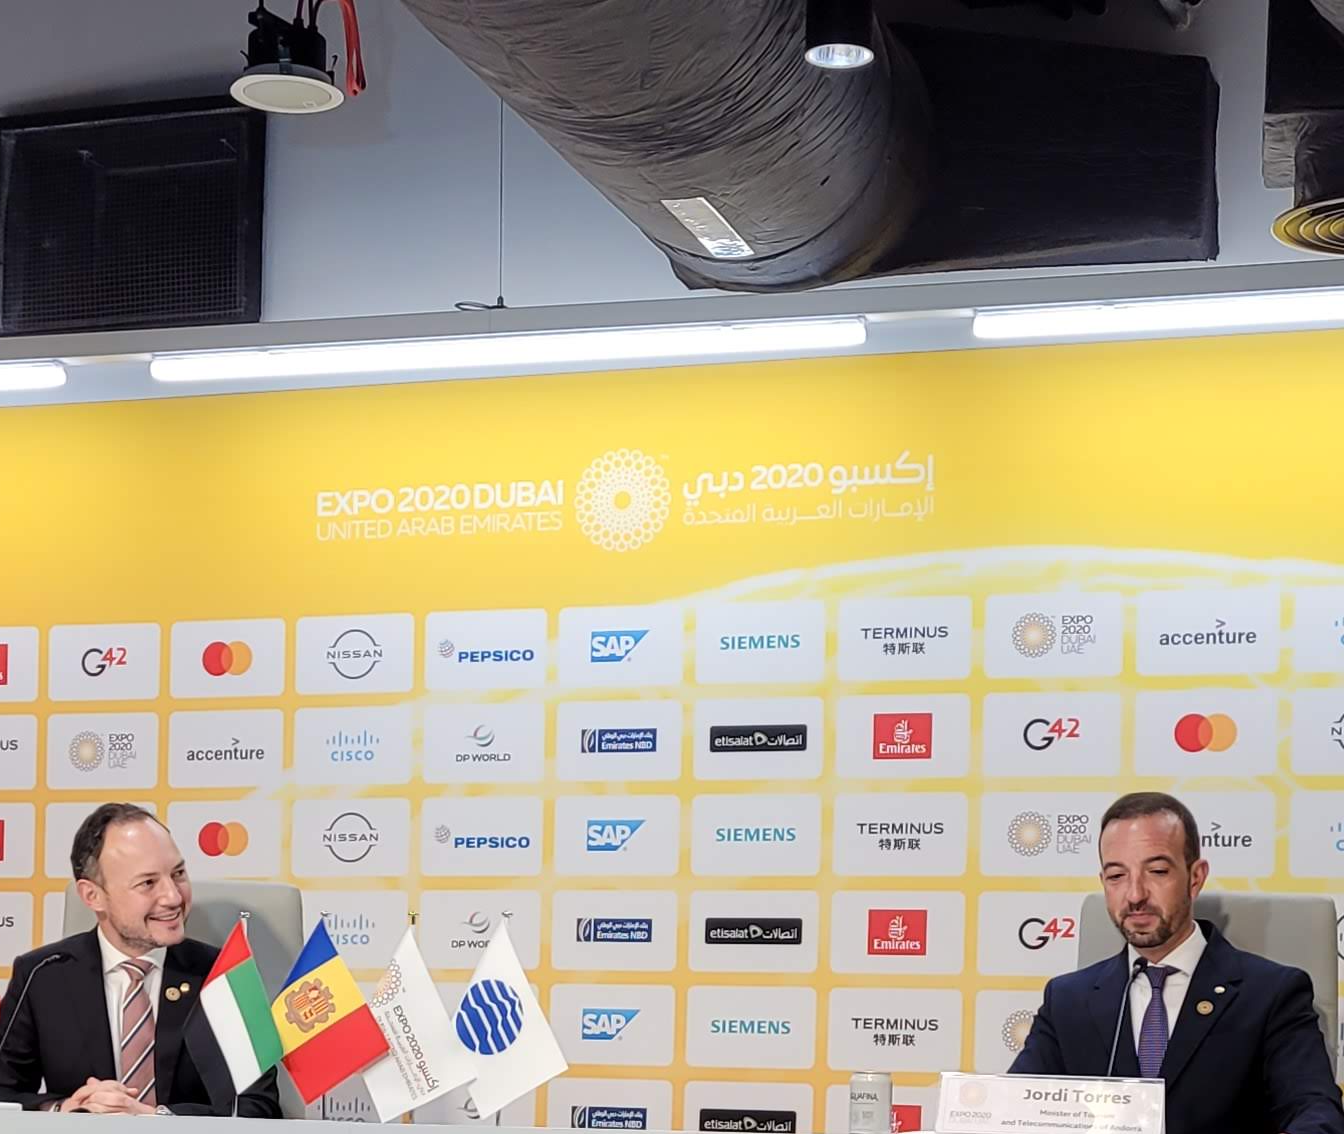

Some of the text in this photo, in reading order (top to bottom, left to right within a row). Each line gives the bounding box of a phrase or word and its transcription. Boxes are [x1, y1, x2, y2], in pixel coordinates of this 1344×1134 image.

[683, 451, 933, 505] إكسبو 2020 دبي
[317, 480, 564, 516] EXPO 2020 DUBAI
[683, 496, 933, 526] الإمارات العربية المتحدة
[317, 511, 562, 542] UNITED ARAB EMIRATES
[1062, 615, 1093, 624] EXPO
[861, 626, 948, 639] TERMINUS
[1062, 625, 1090, 634] 2020
[720, 635, 800, 650] SIEMENS
[1160, 630, 1256, 645] accenture
[591, 635, 634, 658] SAP
[883, 642, 925, 655] 特斯联
[327, 650, 382, 658] NISSAN
[459, 650, 534, 662] PEPSICO
[82, 648, 126, 676] G42
[715, 736, 753, 746] etisalat
[1024, 719, 1079, 750] G42
[187, 748, 264, 760] accenture
[879, 741, 926, 754] Emirates
[331, 750, 374, 761] CISCO
[456, 754, 510, 762] DP WORLD
[1058, 815, 1088, 824] EXPO
[716, 828, 796, 841] SIEMENS
[857, 823, 943, 834] TERMINUS
[1057, 825, 1086, 834] 2020
[323, 834, 378, 842] NISSAN
[455, 837, 530, 848] PEPSICO
[588, 824, 630, 848] SAP
[879, 838, 920, 850] 特斯联
[710, 928, 748, 938] etisalat
[1019, 918, 1074, 950] G42
[874, 937, 921, 951] Emirates
[583, 1014, 625, 1038] SAP
[711, 1020, 790, 1034] SIEMENS
[852, 1018, 938, 1031] TERMINUS
[874, 1034, 915, 1046] 特斯联
[1024, 1088, 1132, 1104] Jordi Torres
